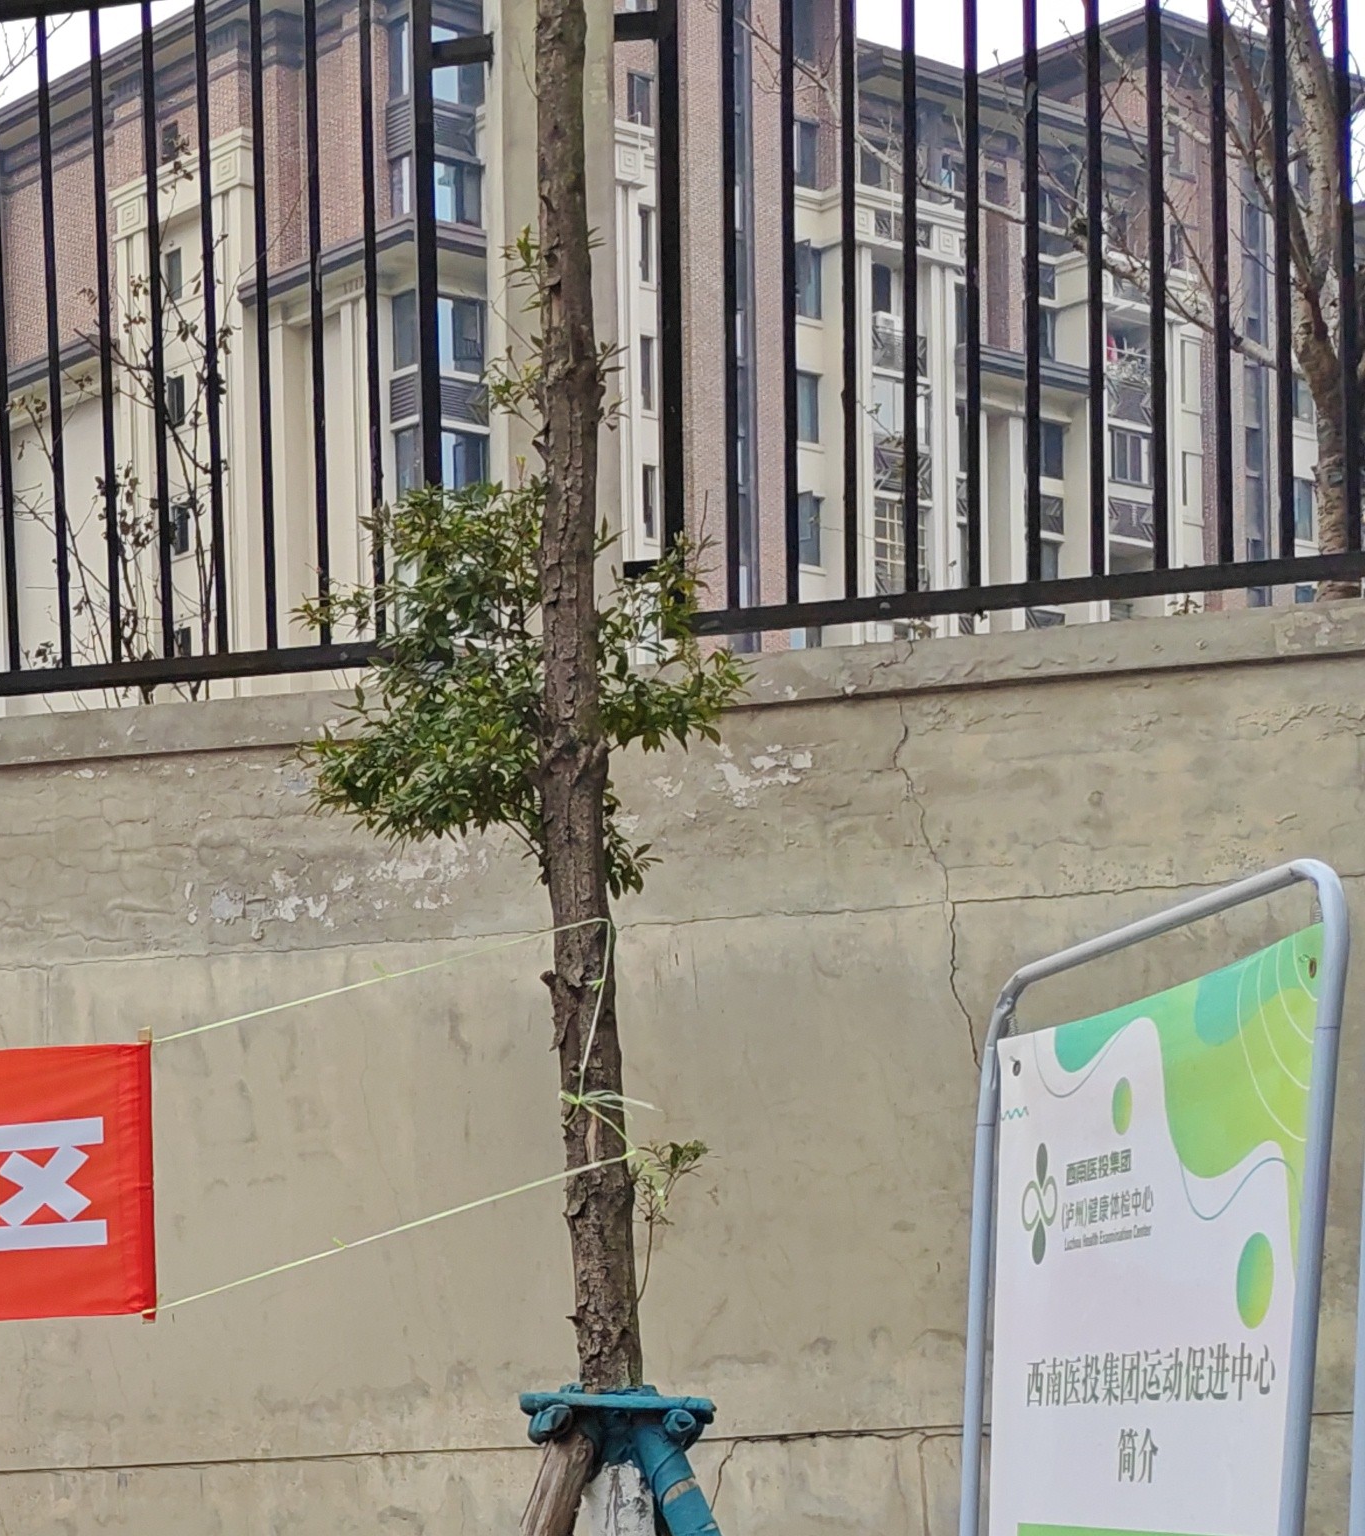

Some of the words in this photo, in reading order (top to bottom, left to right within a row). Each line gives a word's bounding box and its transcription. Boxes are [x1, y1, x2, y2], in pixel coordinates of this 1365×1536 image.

[1066, 1148, 1132, 1187] 西南医投集团
[1026, 1342, 1276, 1407] 西南医投集团运动促进中心
[1117, 1428, 1158, 1484] 简介
